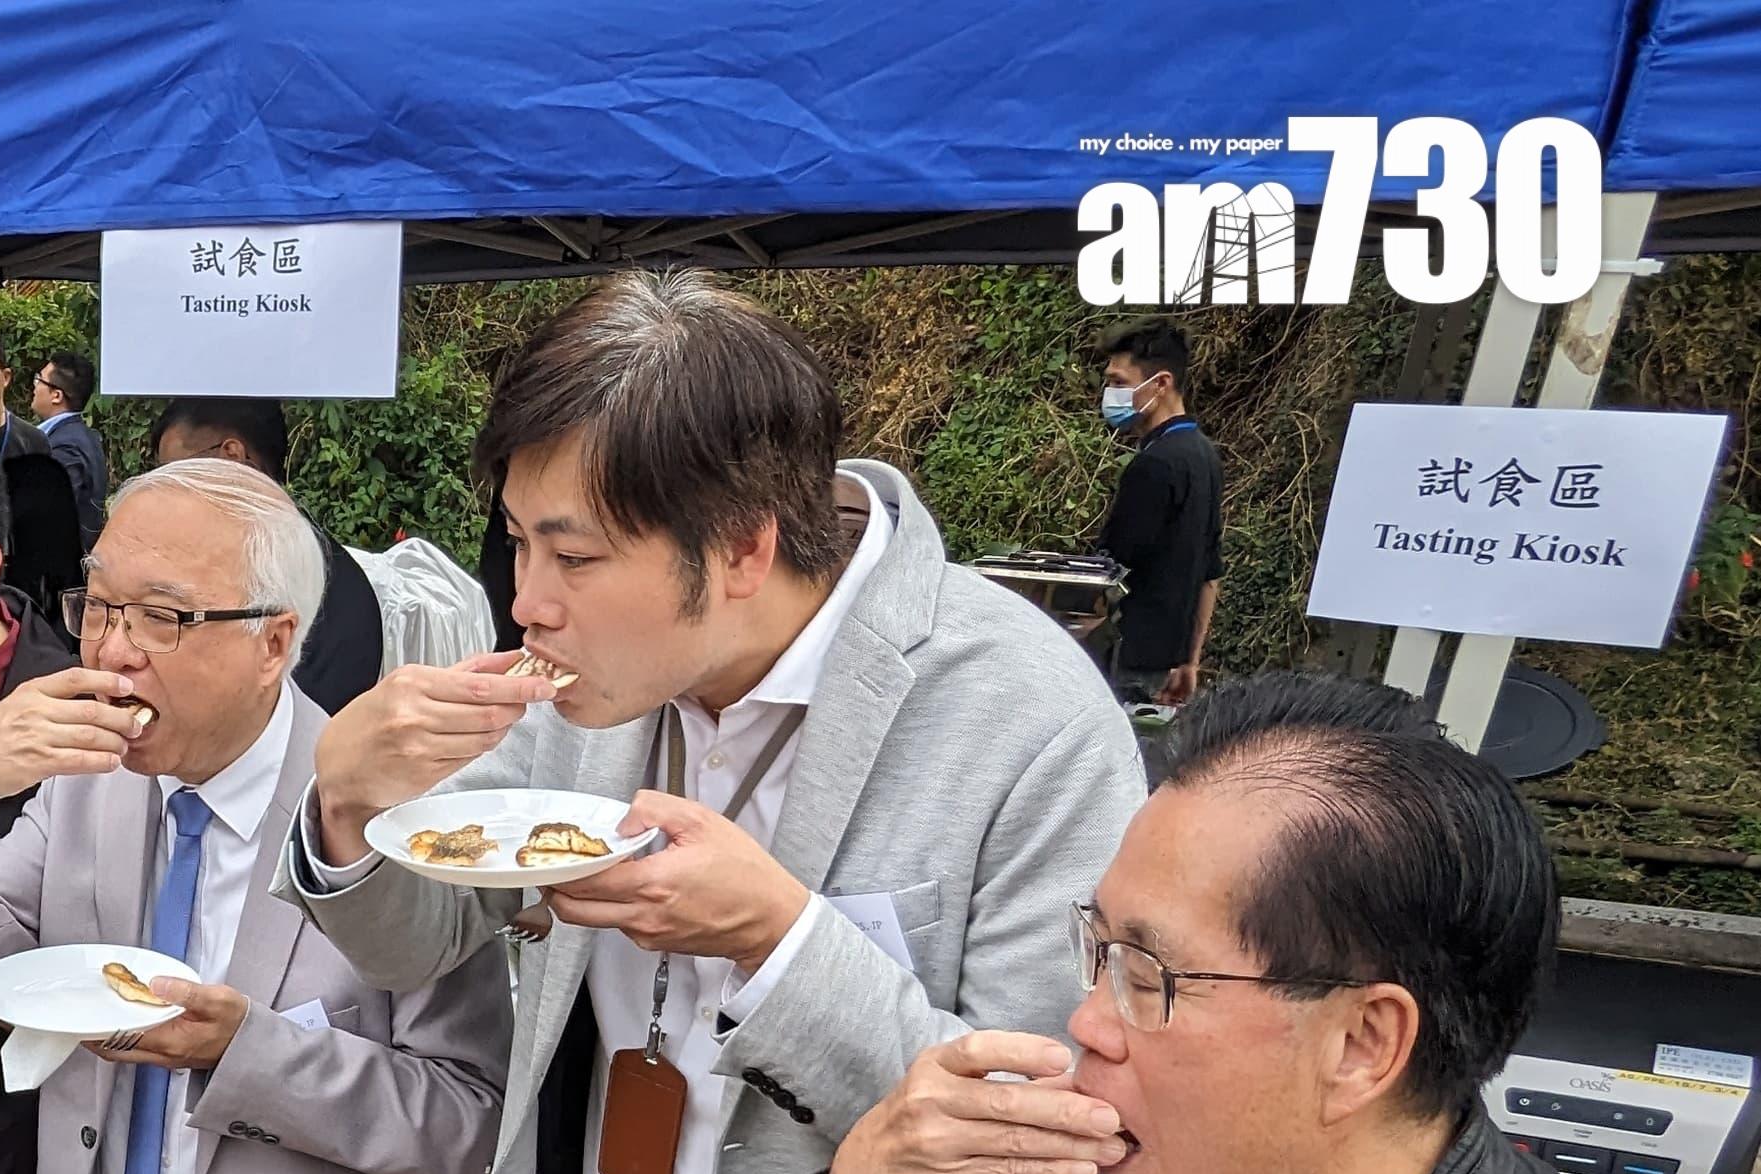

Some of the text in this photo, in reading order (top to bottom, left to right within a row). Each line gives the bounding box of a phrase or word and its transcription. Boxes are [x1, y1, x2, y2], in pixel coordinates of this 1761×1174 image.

[190, 236, 303, 278] 試食區
[180, 293, 313, 318] Tasting Kiosk
[1417, 456, 1604, 509] 試食區
[1373, 523, 1628, 568] Tasting Kiosk
